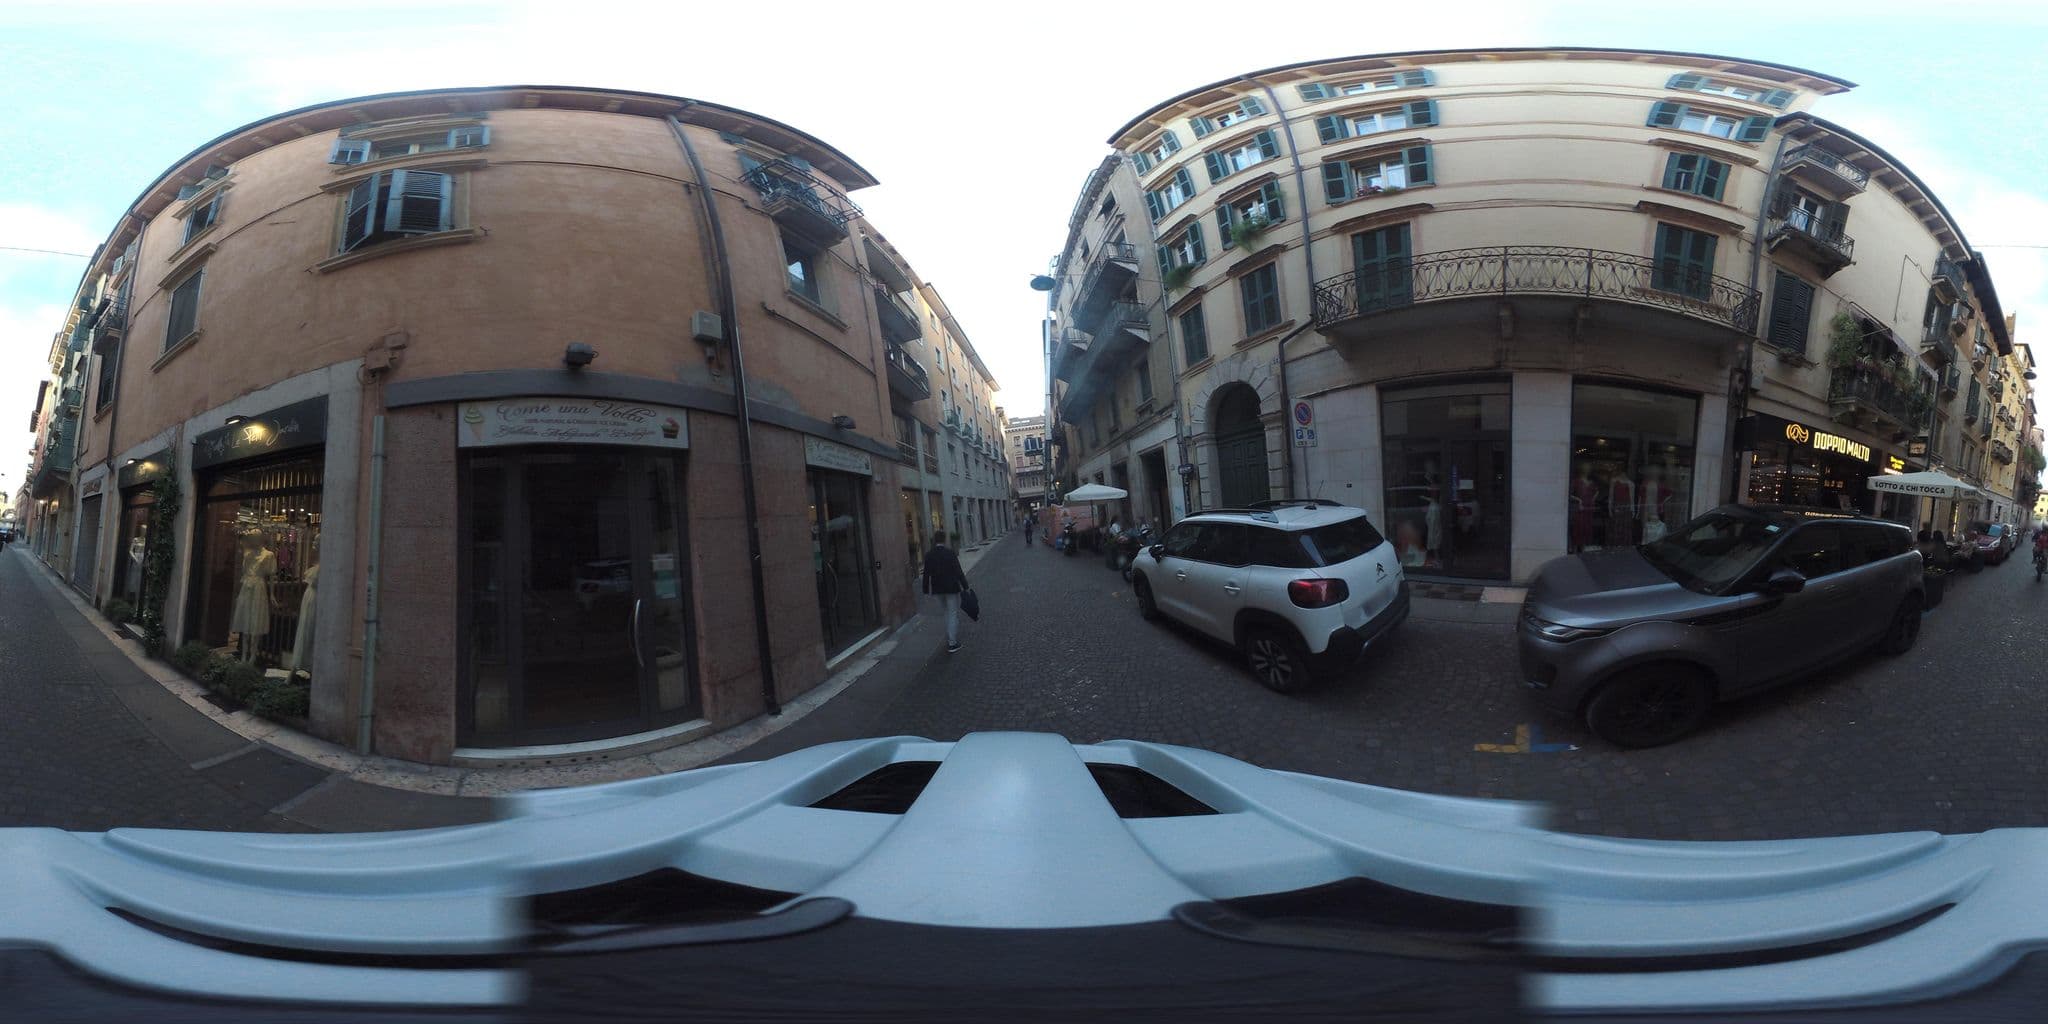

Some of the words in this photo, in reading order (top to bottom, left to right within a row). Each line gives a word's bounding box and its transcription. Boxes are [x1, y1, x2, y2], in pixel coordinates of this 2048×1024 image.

[497, 401, 550, 422] Come
[558, 406, 590, 415] una
[592, 400, 656, 423] Volta
[1813, 431, 1847, 453] DOPPIO
[1847, 439, 1870, 462] MALTO
[1875, 481, 1897, 490] SOTTO
[1906, 484, 1918, 492] CHI
[1920, 486, 1945, 495] TOCCA
